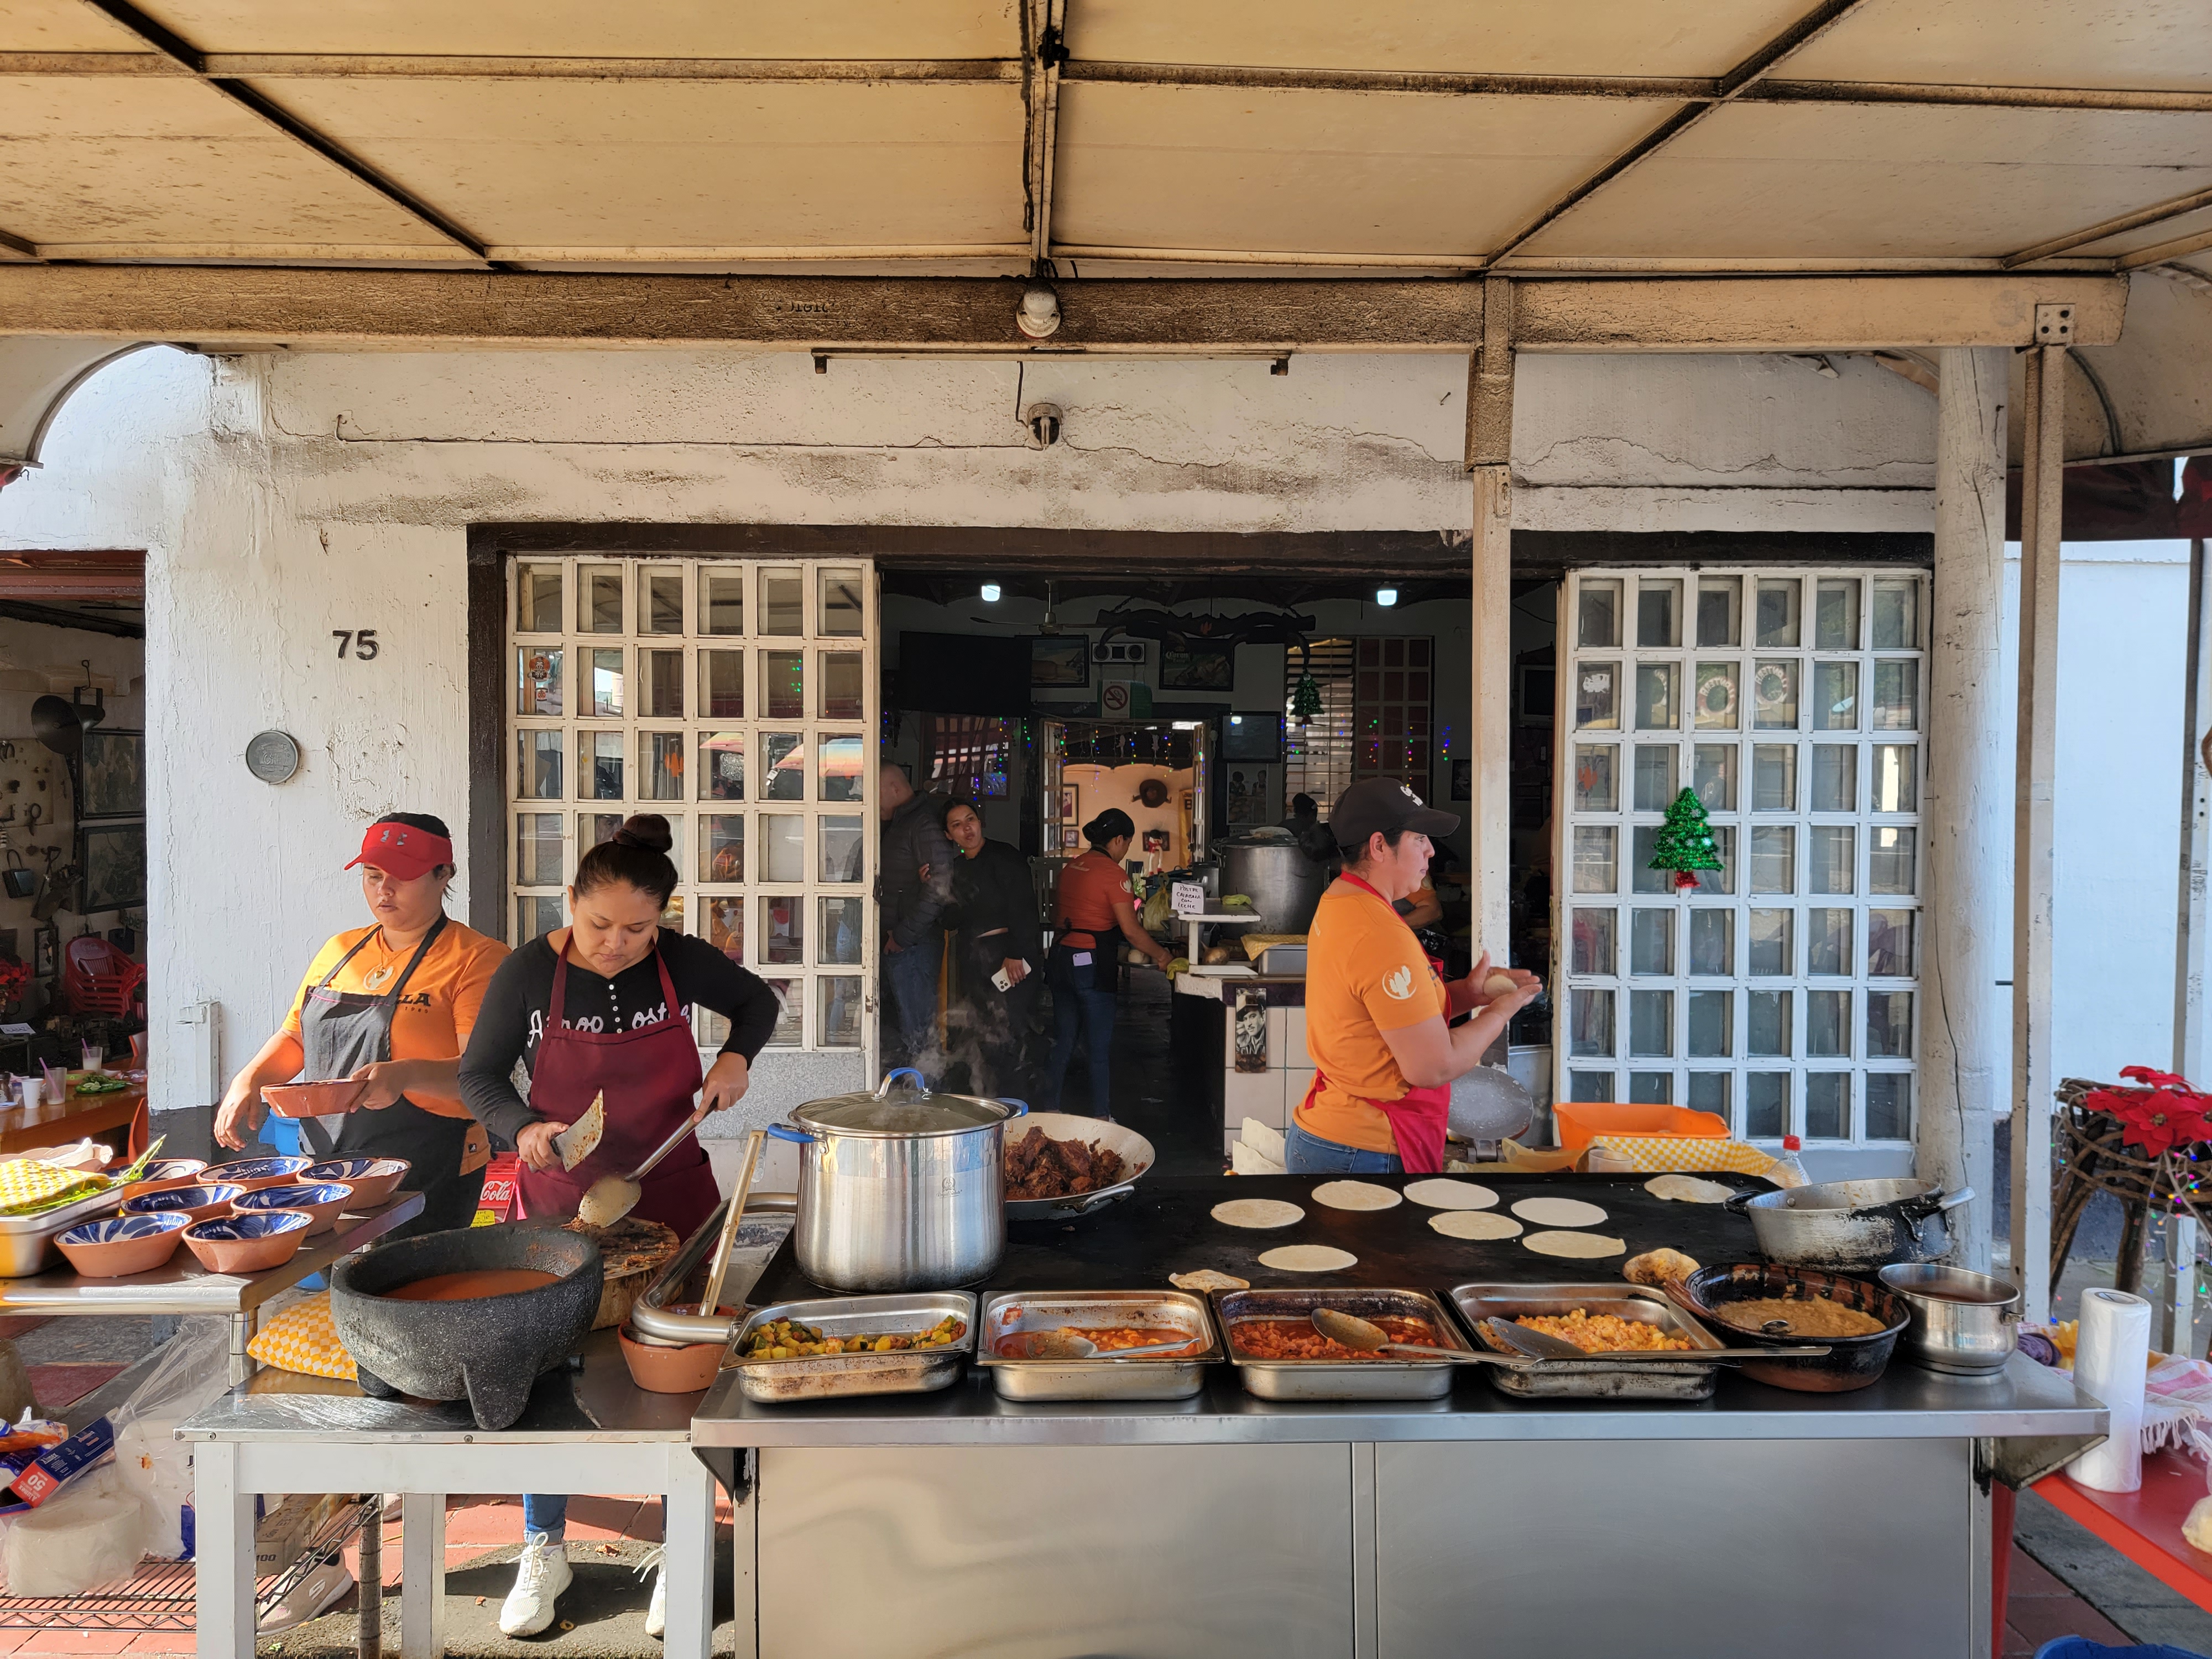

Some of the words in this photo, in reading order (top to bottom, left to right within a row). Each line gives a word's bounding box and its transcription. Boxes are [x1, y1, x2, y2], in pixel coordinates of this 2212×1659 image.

[332, 629, 379, 660] 75
[1179, 884, 1198, 893] POSTRE
[479, 1181, 513, 1201] Cola
[28, 1474, 45, 1491] 50
[18, 1484, 38, 1502] Alumex
